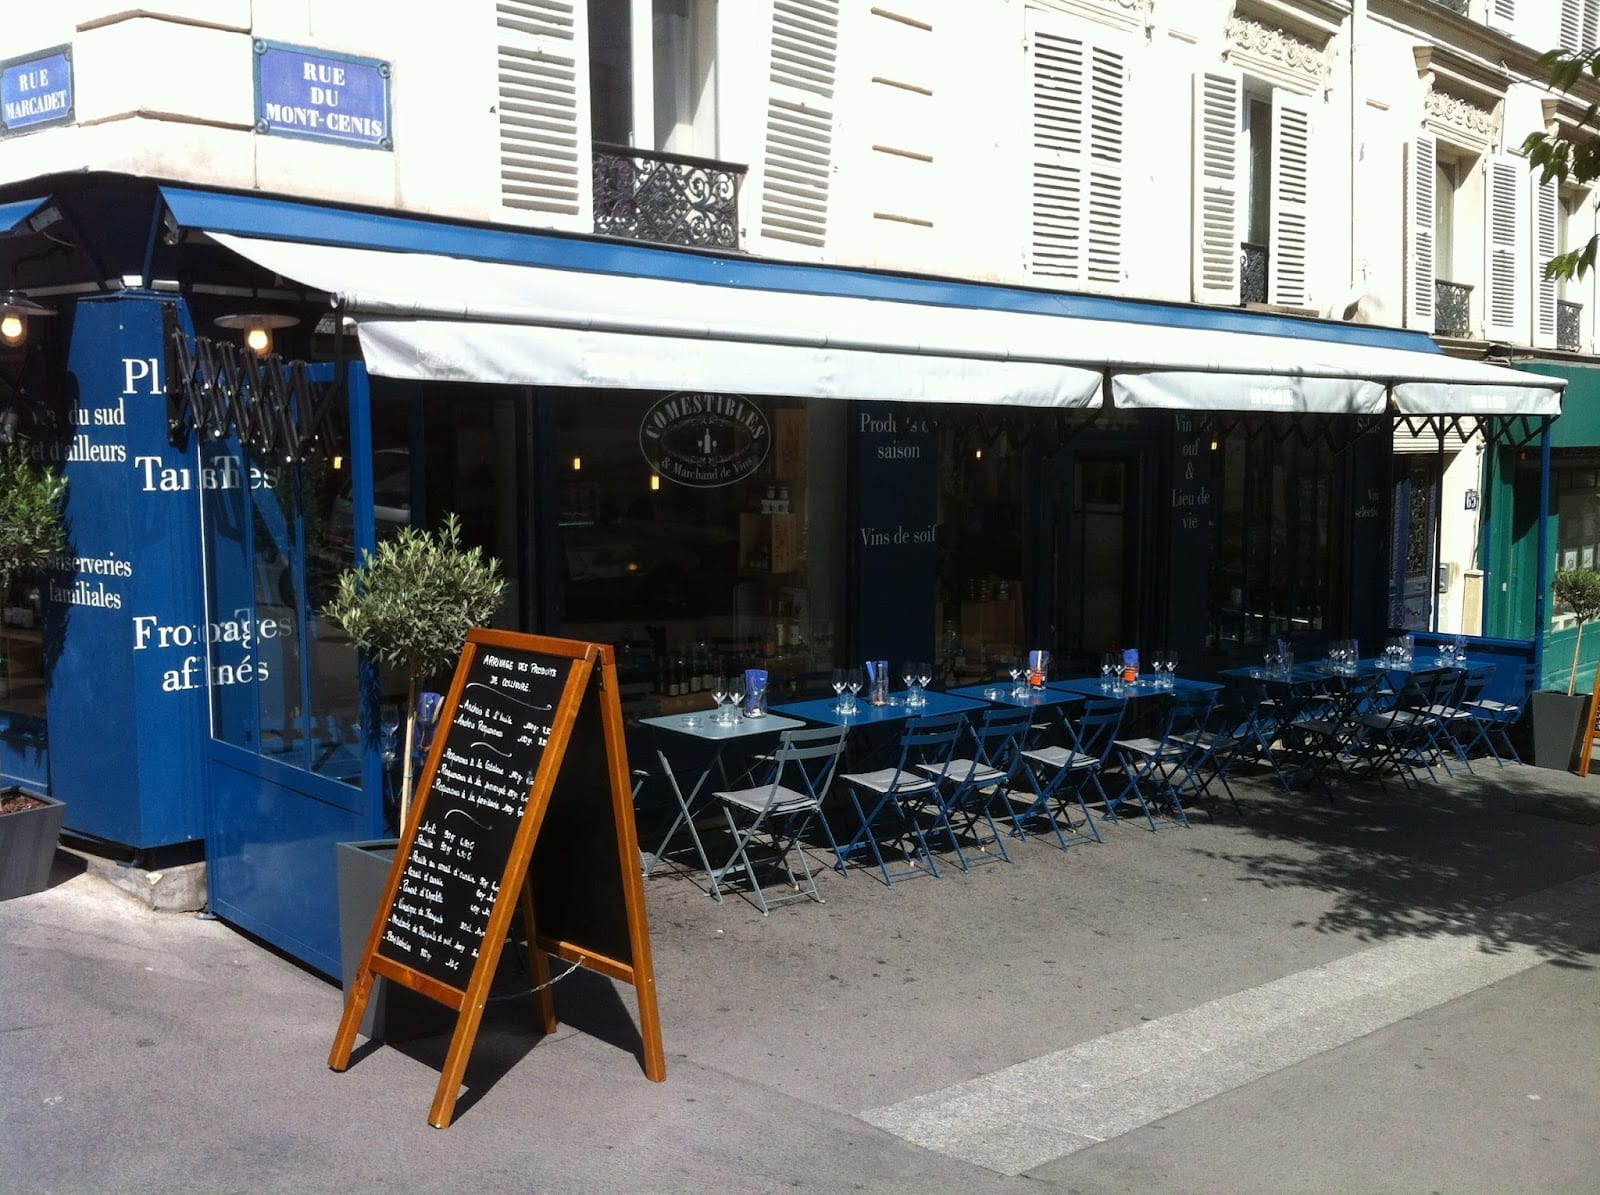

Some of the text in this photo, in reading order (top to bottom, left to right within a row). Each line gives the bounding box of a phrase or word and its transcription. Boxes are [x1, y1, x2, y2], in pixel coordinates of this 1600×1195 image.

[19, 69, 49, 92] RUE
[303, 62, 346, 86] RUE
[5, 90, 67, 120] MARCADET
[310, 86, 339, 107] DU
[265, 103, 383, 138] MONT-CENIS
[69, 398, 90, 426] du
[94, 397, 126, 426] sud
[646, 393, 766, 440] COMESTIBLES
[49, 434, 127, 462] d'ailleurs
[877, 440, 921, 459] saison
[673, 462, 718, 481] Marchand
[720, 466, 731, 479] de
[1184, 461, 1194, 480] &
[1172, 486, 1210, 507] Lieu de
[1466, 492, 1477, 508] 65
[1182, 512, 1199, 529] vie
[860, 524, 938, 546] Vins de soif
[46, 552, 133, 578] onserveries
[49, 578, 122, 610] familiales
[518, 663, 528, 672] DES
